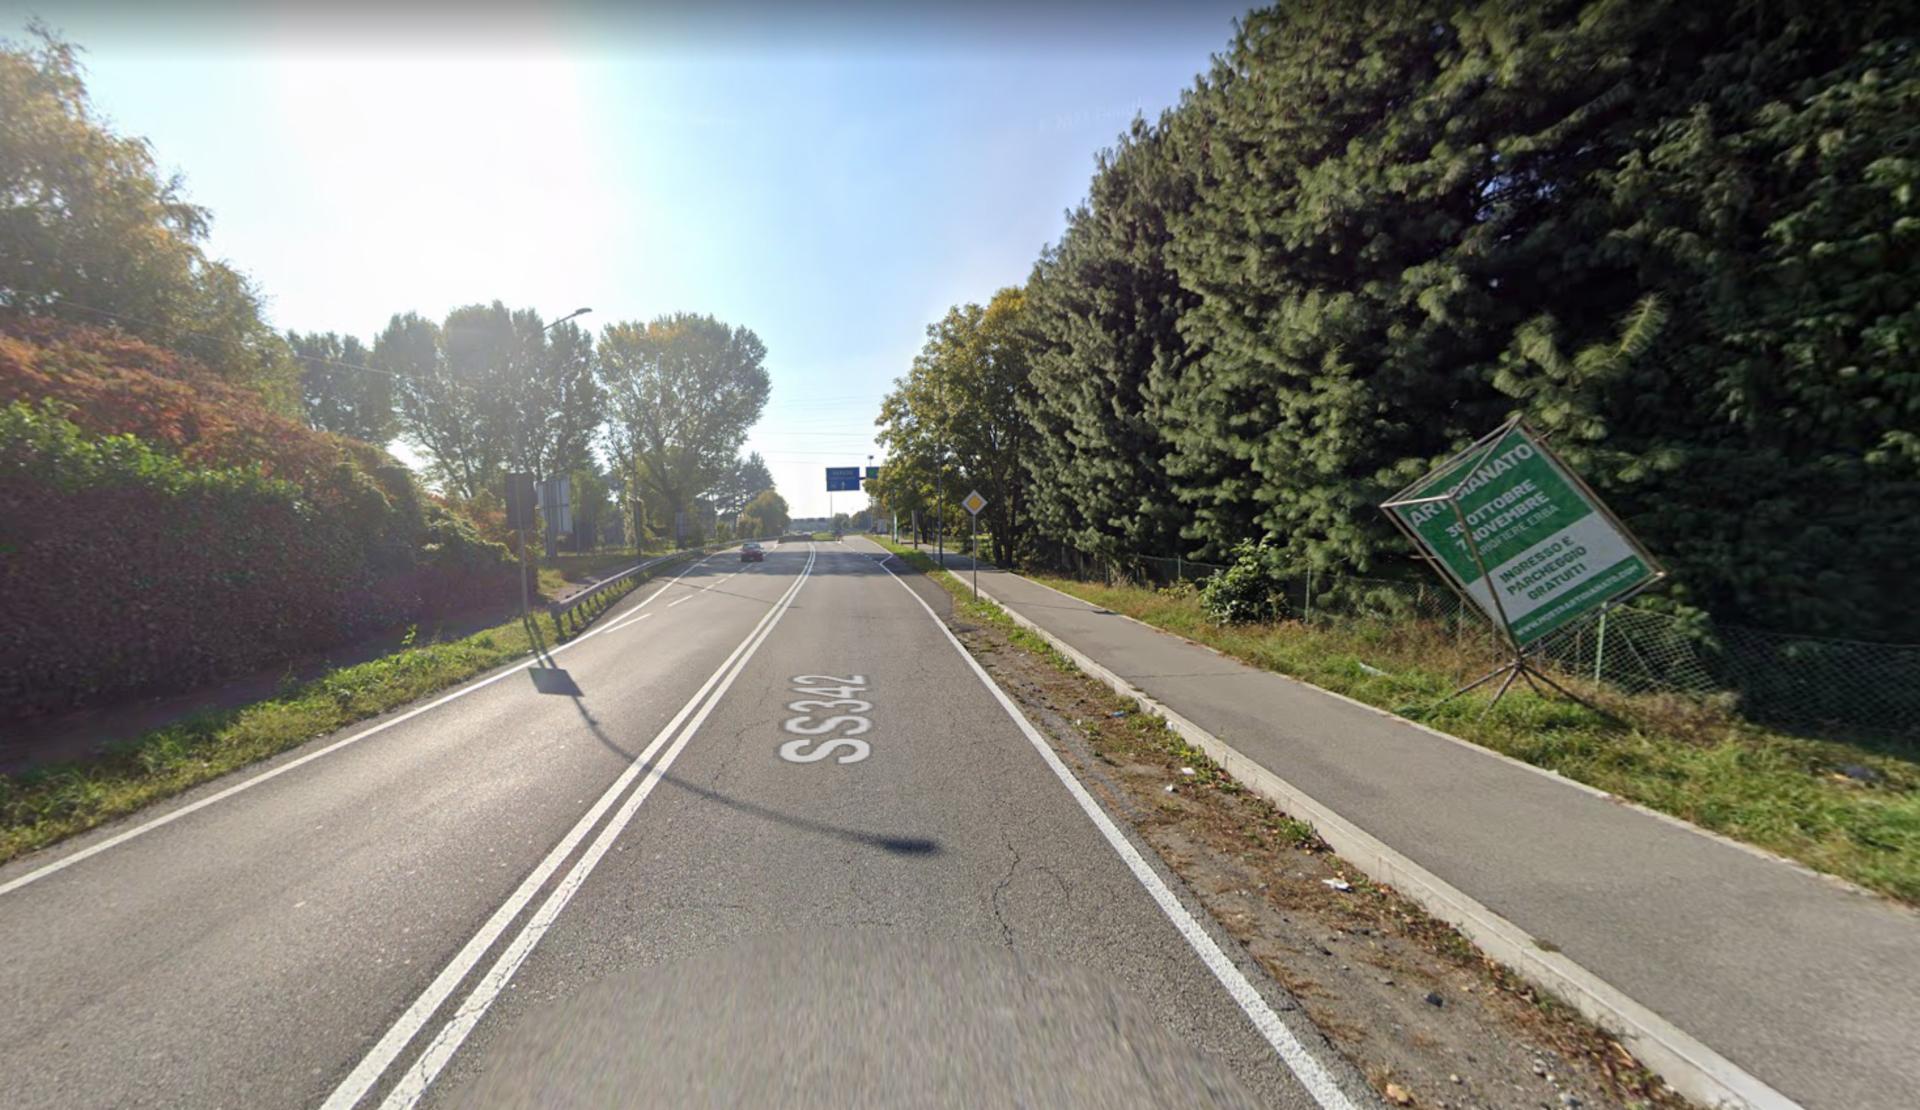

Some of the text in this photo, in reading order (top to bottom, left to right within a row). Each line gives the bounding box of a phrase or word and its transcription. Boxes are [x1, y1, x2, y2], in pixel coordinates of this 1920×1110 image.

[1466, 478, 1537, 526] OTTOBRE
[1455, 538, 1467, 551] 7
[1499, 535, 1575, 583] INGRESSO E
[1505, 546, 1587, 596] PARCHEGGIO
[1527, 563, 1587, 600] GRATUITI
